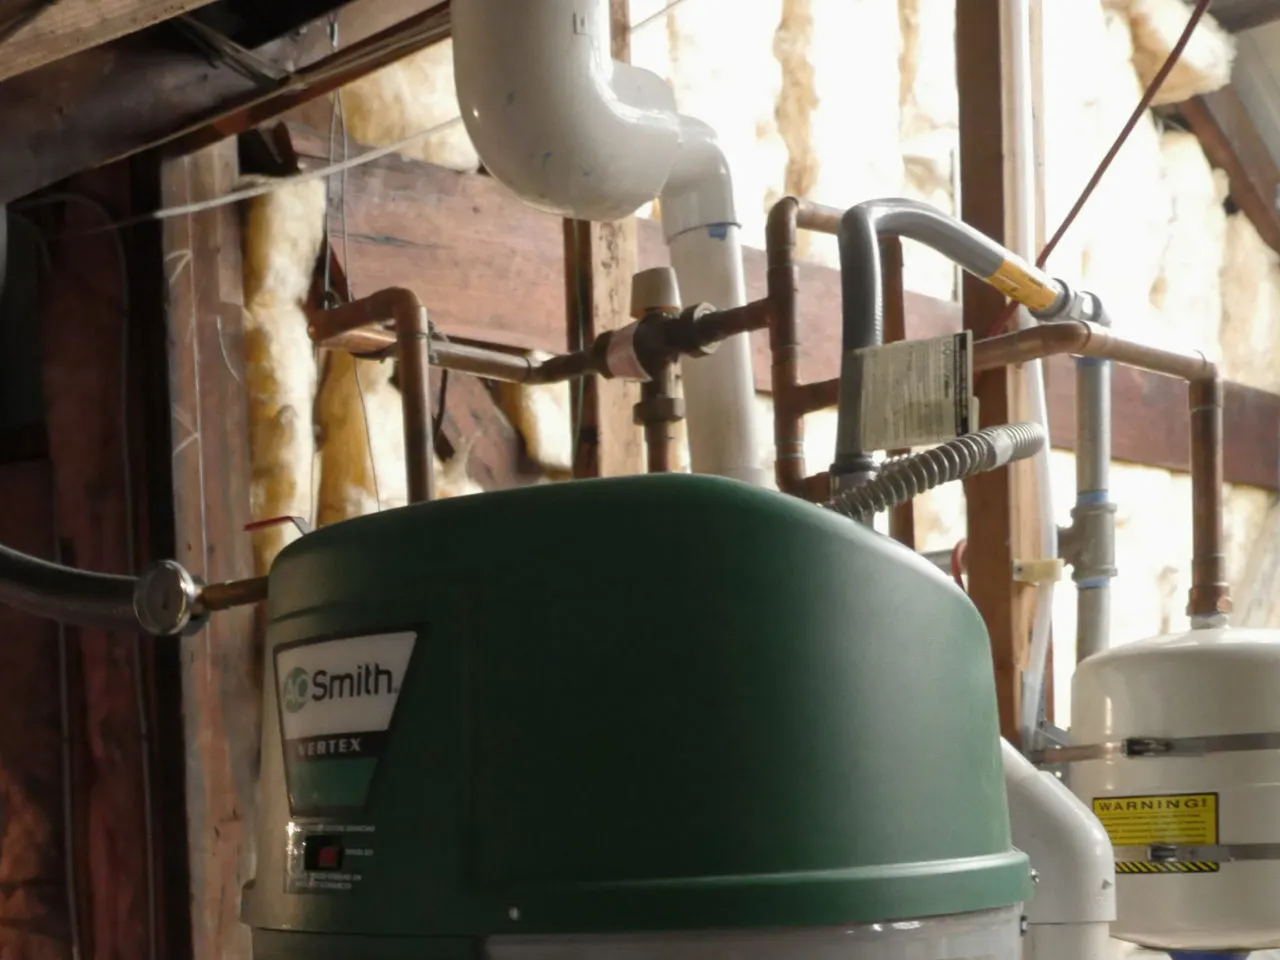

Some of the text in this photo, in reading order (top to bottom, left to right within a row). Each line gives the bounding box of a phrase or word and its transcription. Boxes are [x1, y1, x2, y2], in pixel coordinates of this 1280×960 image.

[312, 662, 393, 701] Smith
[299, 737, 362, 757] VERTEX
[1099, 798, 1207, 812] WARNING!
